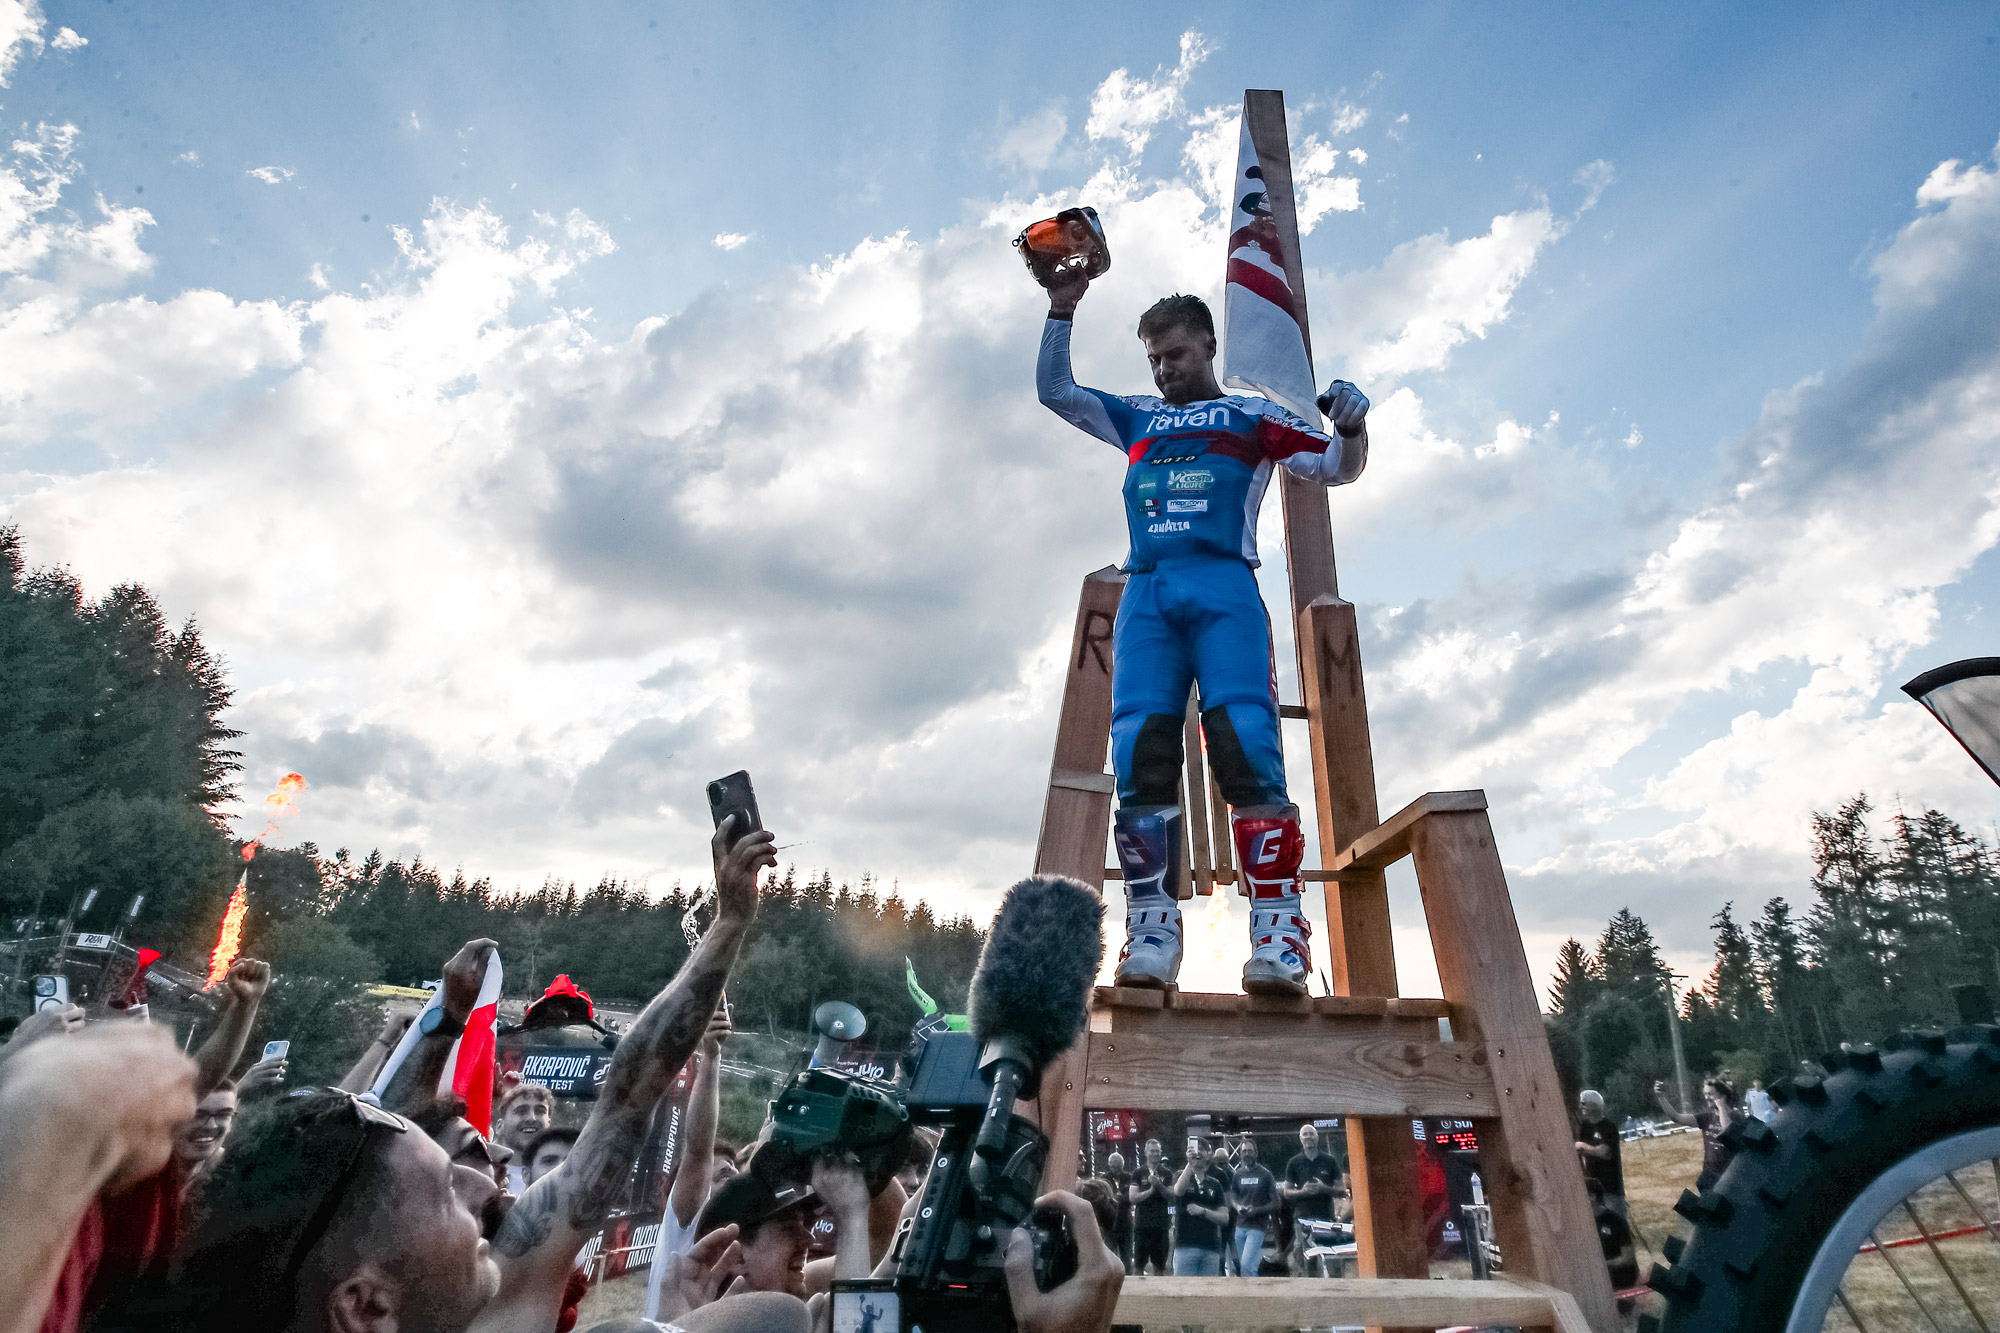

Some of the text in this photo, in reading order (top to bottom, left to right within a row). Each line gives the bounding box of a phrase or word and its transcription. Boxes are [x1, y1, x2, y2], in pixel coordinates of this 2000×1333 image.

[1146, 407, 1229, 433] raven
[1151, 455, 1196, 465] MOTO
[522, 1055, 591, 1078] AKRAPOVIČ
[521, 1078, 574, 1090] UPER TEST
